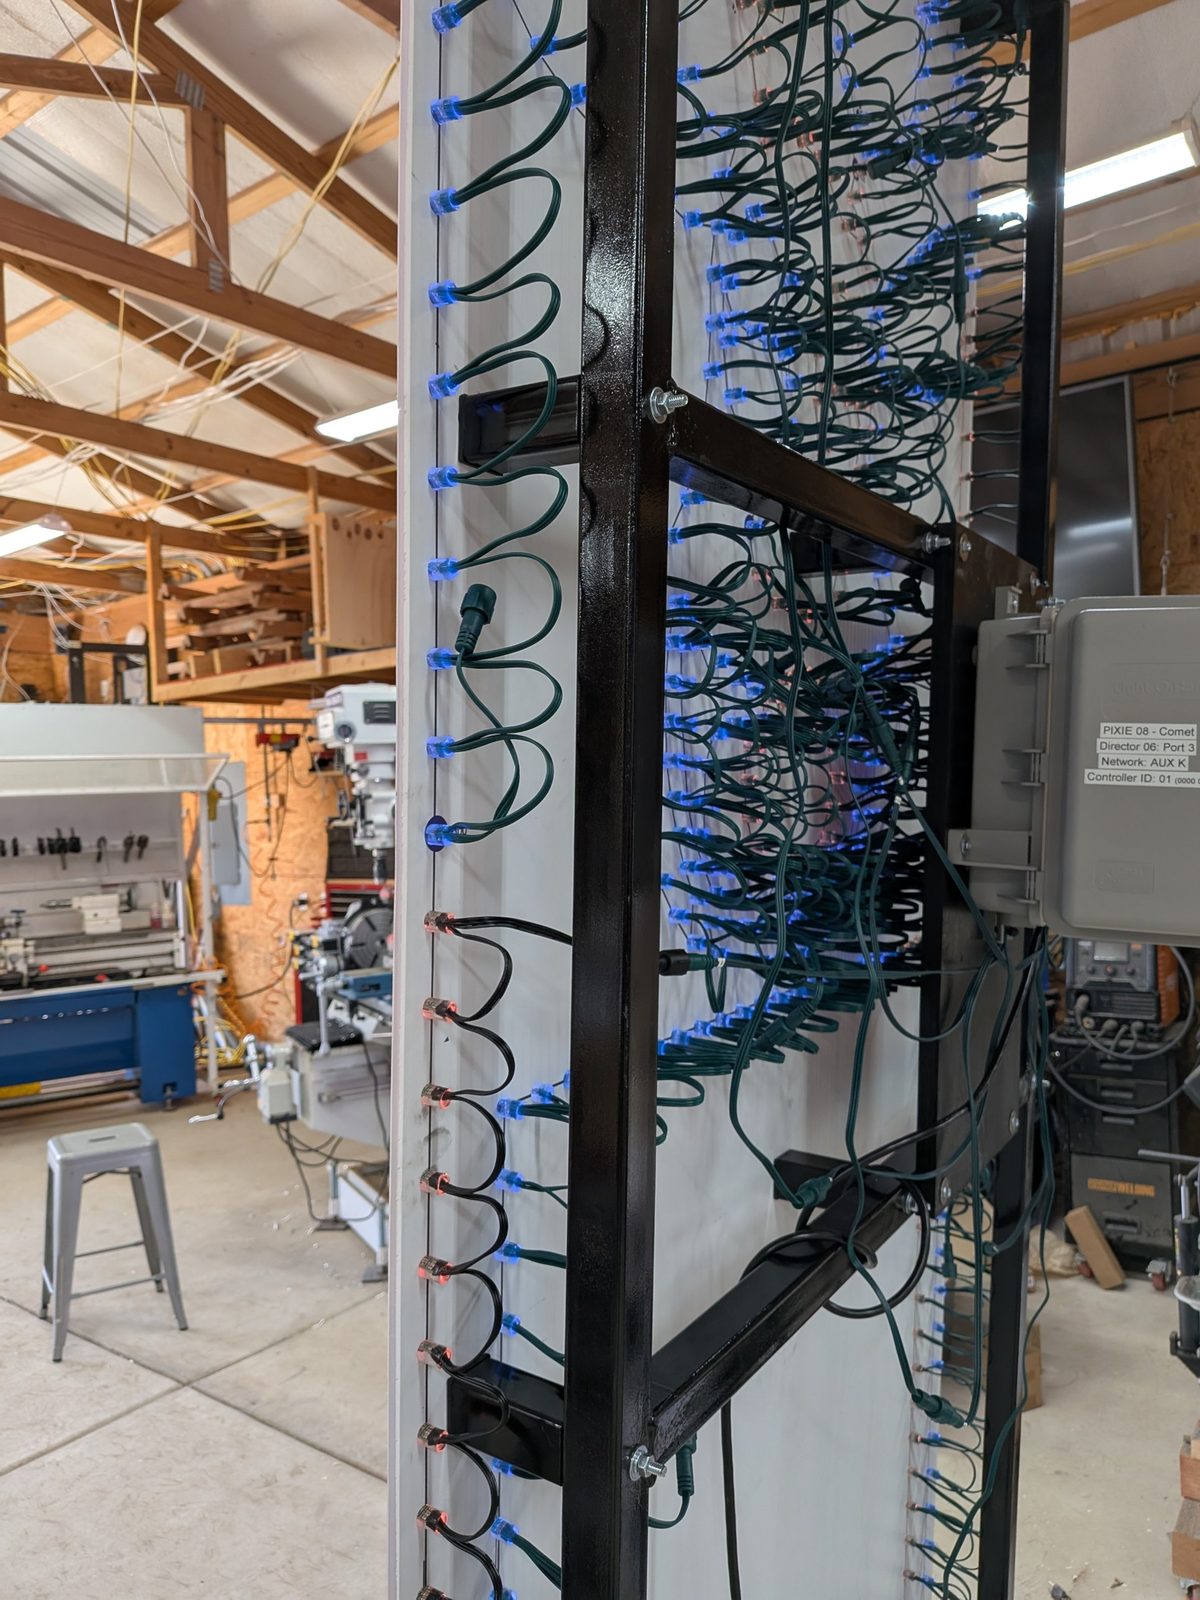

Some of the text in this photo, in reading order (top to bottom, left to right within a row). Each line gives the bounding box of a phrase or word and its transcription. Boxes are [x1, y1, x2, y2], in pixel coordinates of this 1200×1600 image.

[1103, 725, 1133, 735] PIXIE
[1136, 726, 1149, 736] 08
[1159, 726, 1195, 737] Comet
[1099, 741, 1195, 752] Director 06: Port 3
[1101, 757, 1186, 768] Network: AUX K
[1087, 772, 1137, 782] Controller
[1140, 773, 1156, 783] ID:
[1159, 774, 1171, 783] 01
